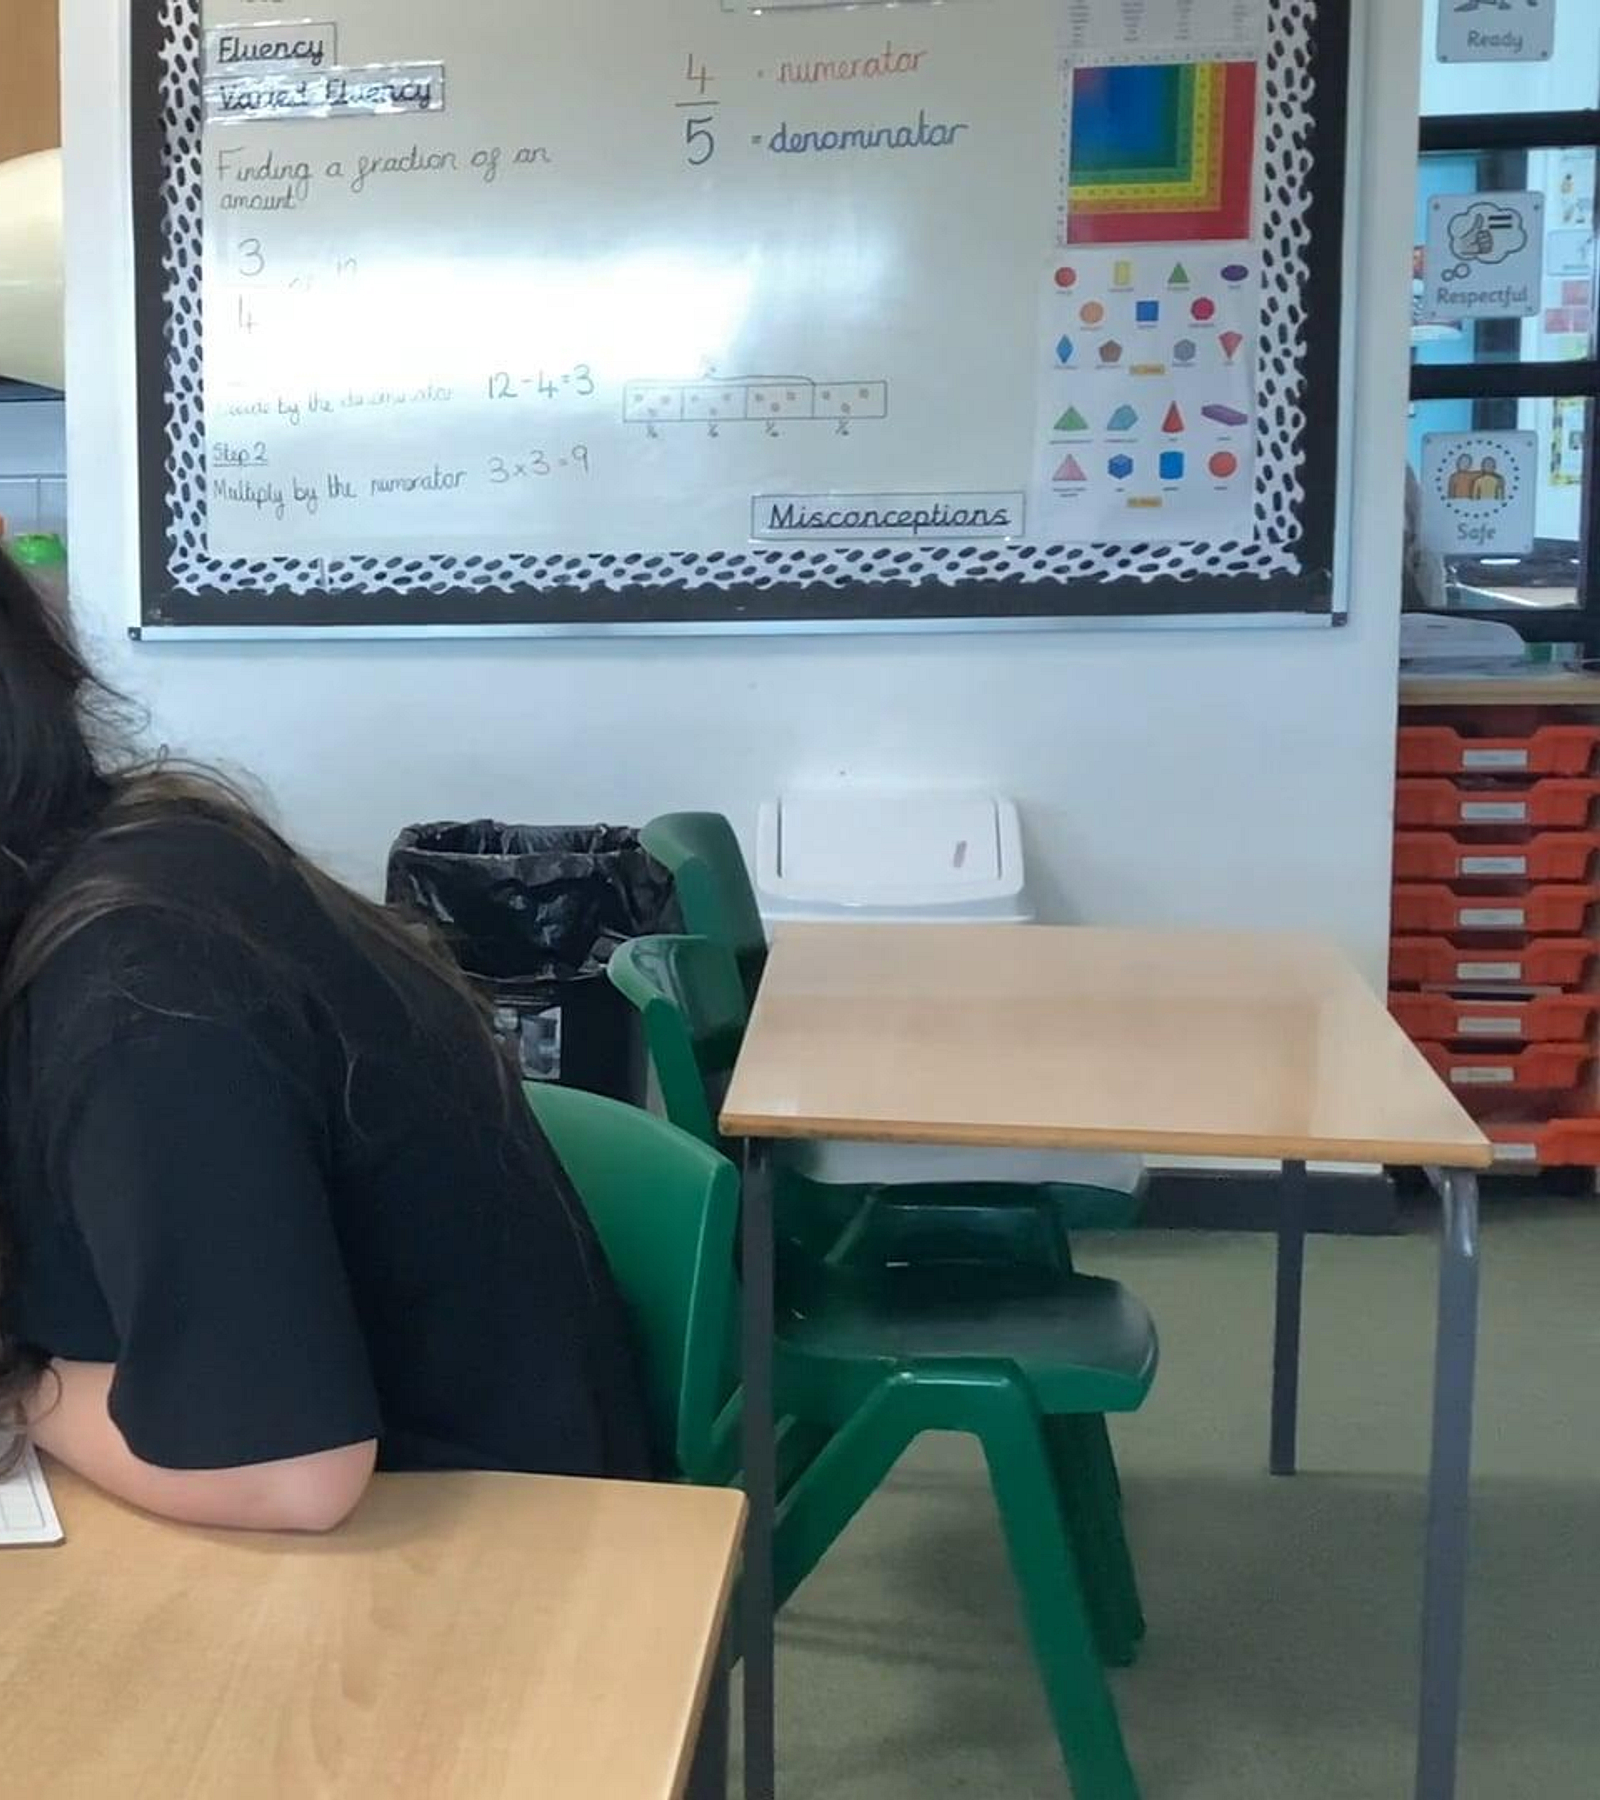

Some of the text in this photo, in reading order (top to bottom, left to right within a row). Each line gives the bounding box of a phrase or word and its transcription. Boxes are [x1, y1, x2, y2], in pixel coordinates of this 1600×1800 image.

[218, 37, 324, 66] Fluency
[1466, 29, 1523, 53] Ready
[686, 53, 715, 94] 4
[776, 40, 928, 84] numerator
[326, 79, 433, 109] Fluency
[686, 116, 715, 166] 5
[768, 109, 969, 153] denominator
[217, 144, 552, 201] Finding a fraction of an
[220, 186, 297, 211] amount
[238, 237, 266, 277] 3
[1436, 285, 1529, 307] Respectful
[213, 441, 267, 467] Step 2
[212, 465, 468, 520] Multiply by the numerator
[768, 503, 1012, 535] Misconceptions
[1457, 522, 1497, 545] Safe
